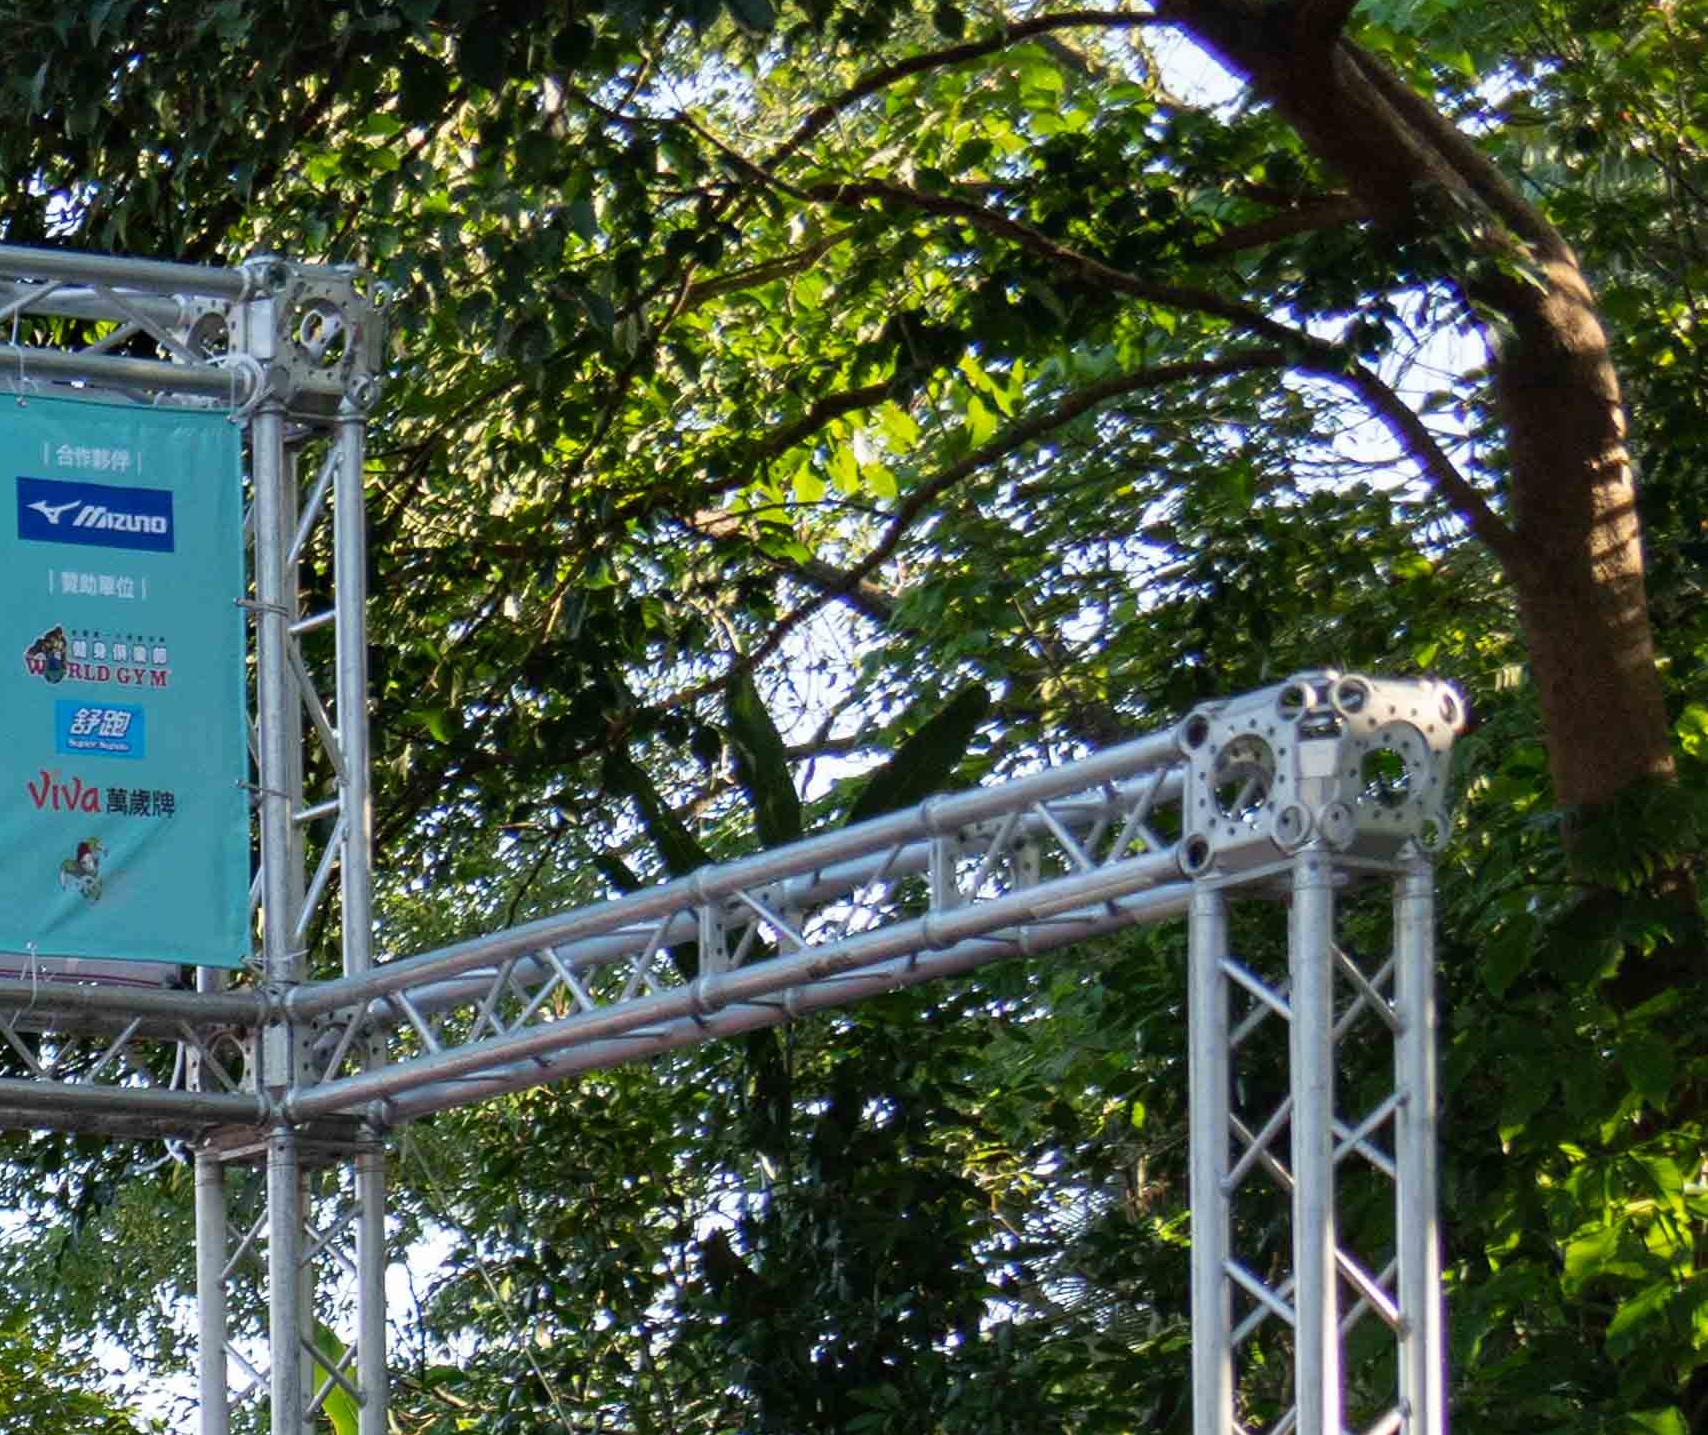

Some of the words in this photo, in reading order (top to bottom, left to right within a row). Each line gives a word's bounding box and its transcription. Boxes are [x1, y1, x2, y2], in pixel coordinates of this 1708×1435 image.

[116, 667, 168, 688] GYM
[69, 707, 132, 737] 舒跑
[105, 788, 176, 818] 萬歲牌
